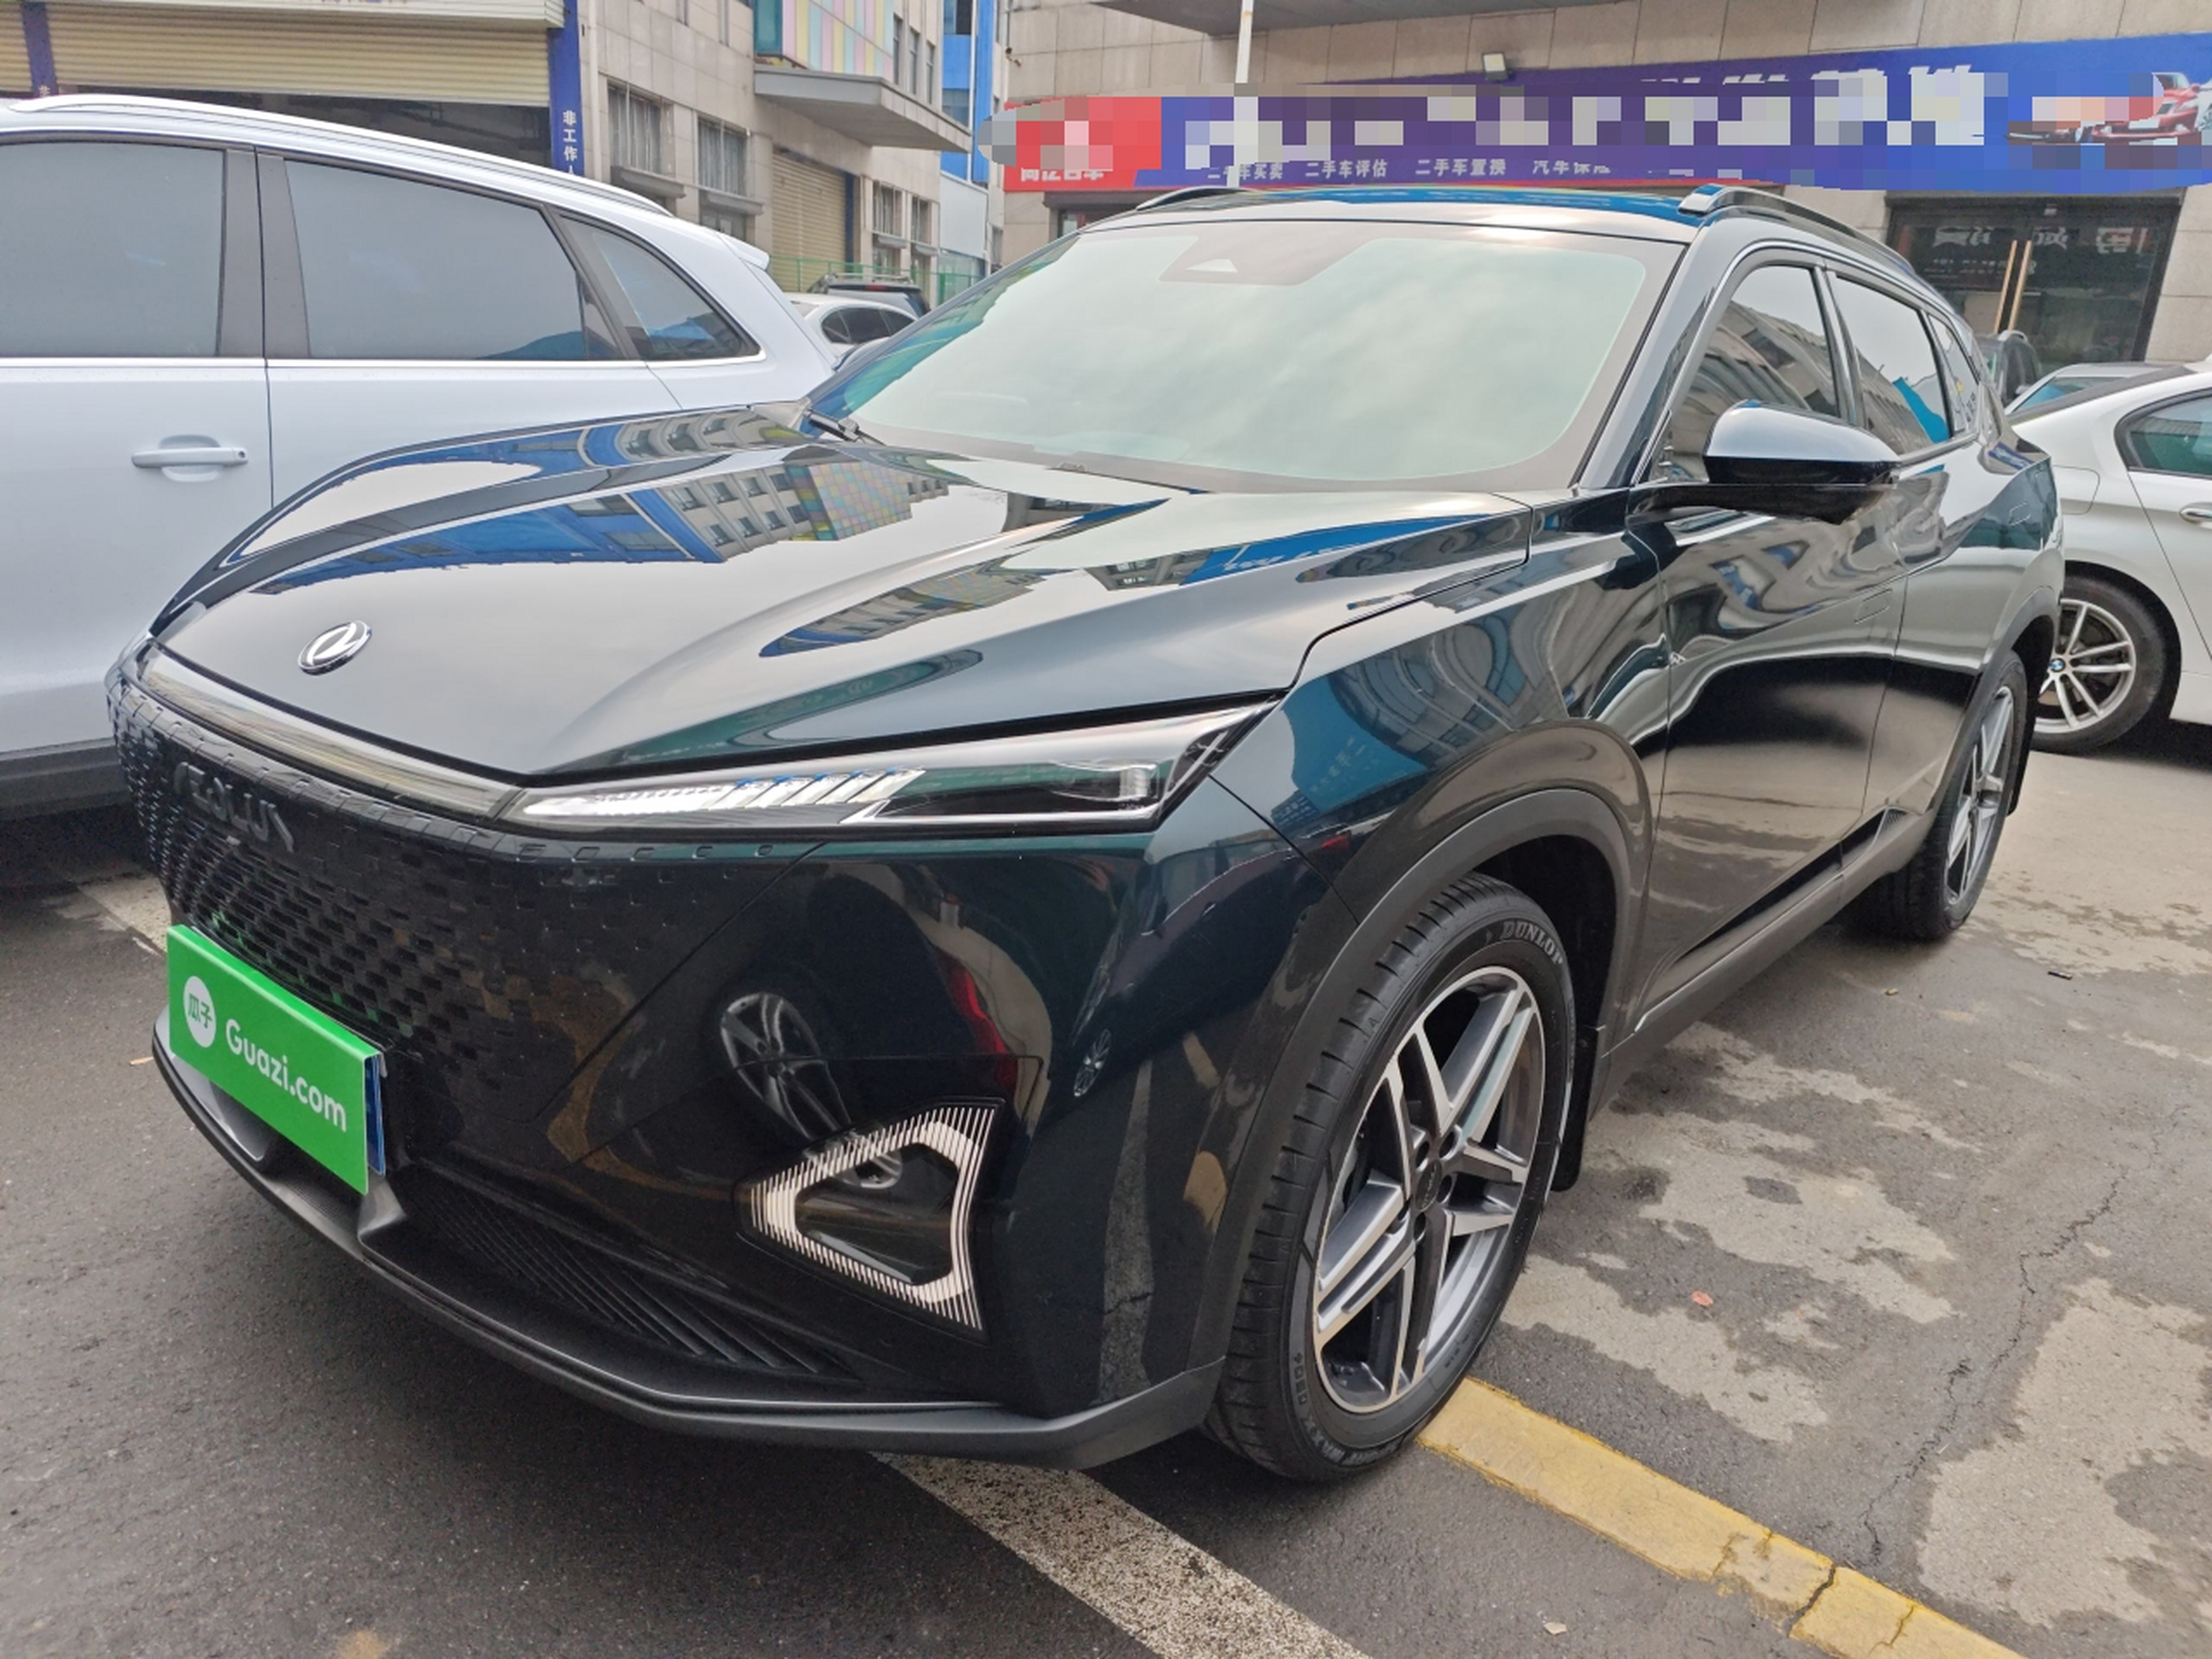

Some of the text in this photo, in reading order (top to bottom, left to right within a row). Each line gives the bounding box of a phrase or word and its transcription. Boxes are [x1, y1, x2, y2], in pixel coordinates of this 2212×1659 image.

[1305, 159, 1388, 179] 二手车评估
[1415, 158, 1506, 177] 二手车置换
[1499, 921, 1563, 965] DUNLOP
[188, 993, 212, 1029] 瓜子
[226, 1018, 347, 1132] Guazi.com
